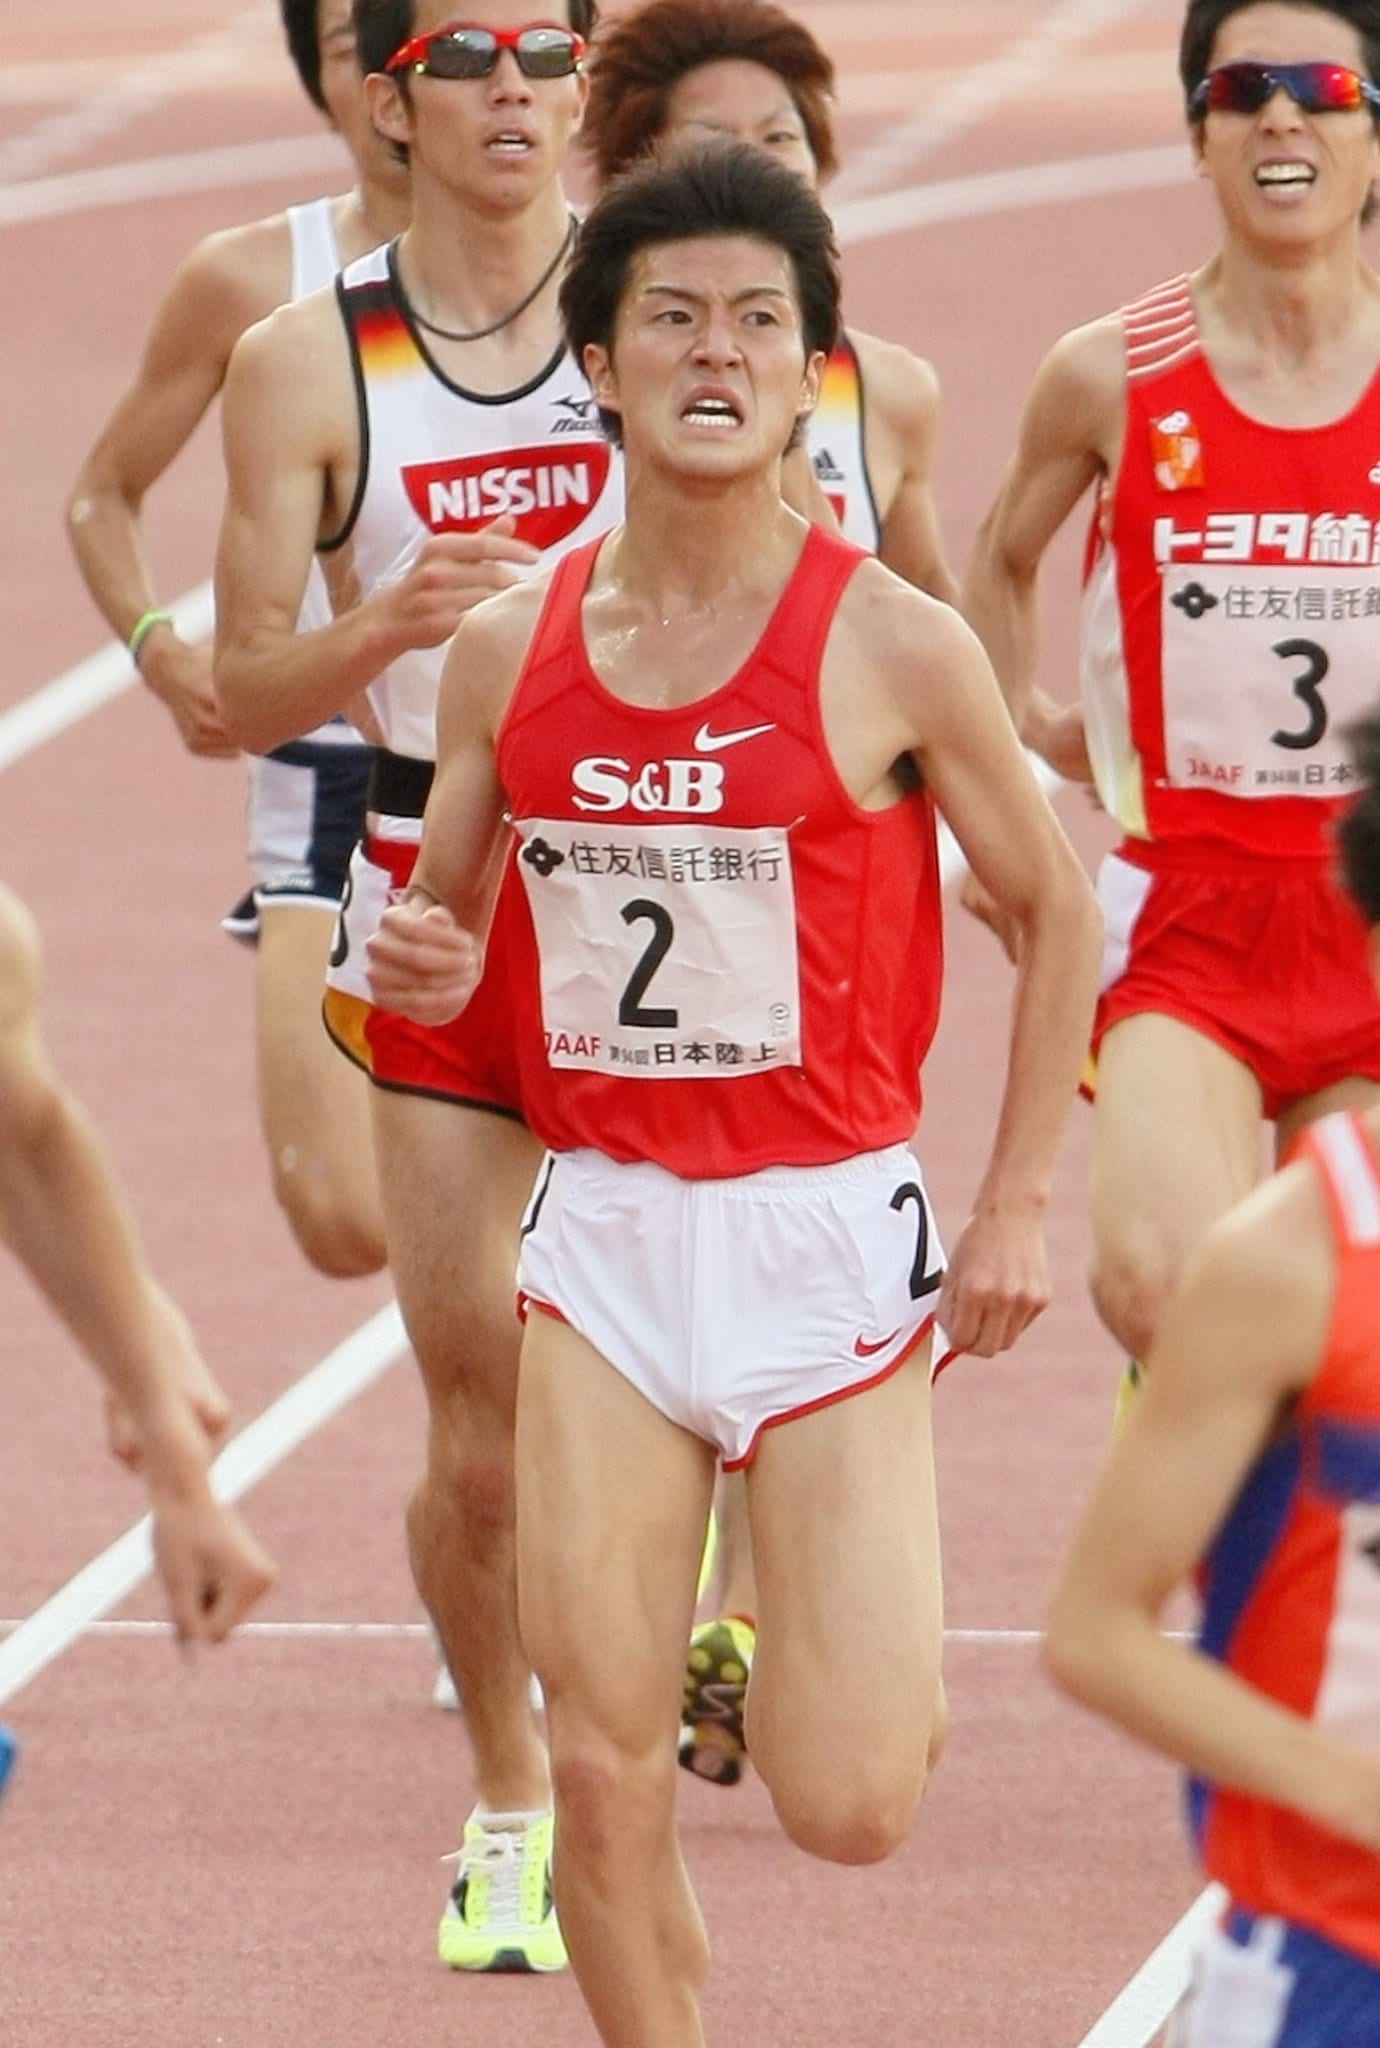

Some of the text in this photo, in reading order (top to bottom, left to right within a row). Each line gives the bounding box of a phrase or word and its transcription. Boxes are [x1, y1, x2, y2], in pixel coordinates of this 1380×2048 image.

[428, 462, 590, 524] NISSIN
[1153, 513, 1380, 562] トヨタ紡
[1271, 638, 1330, 750] 3
[571, 757, 726, 812] S&B
[567, 840, 783, 883] 住友信託銀行
[620, 898, 678, 1029] 2
[889, 1181, 944, 1301] 2
